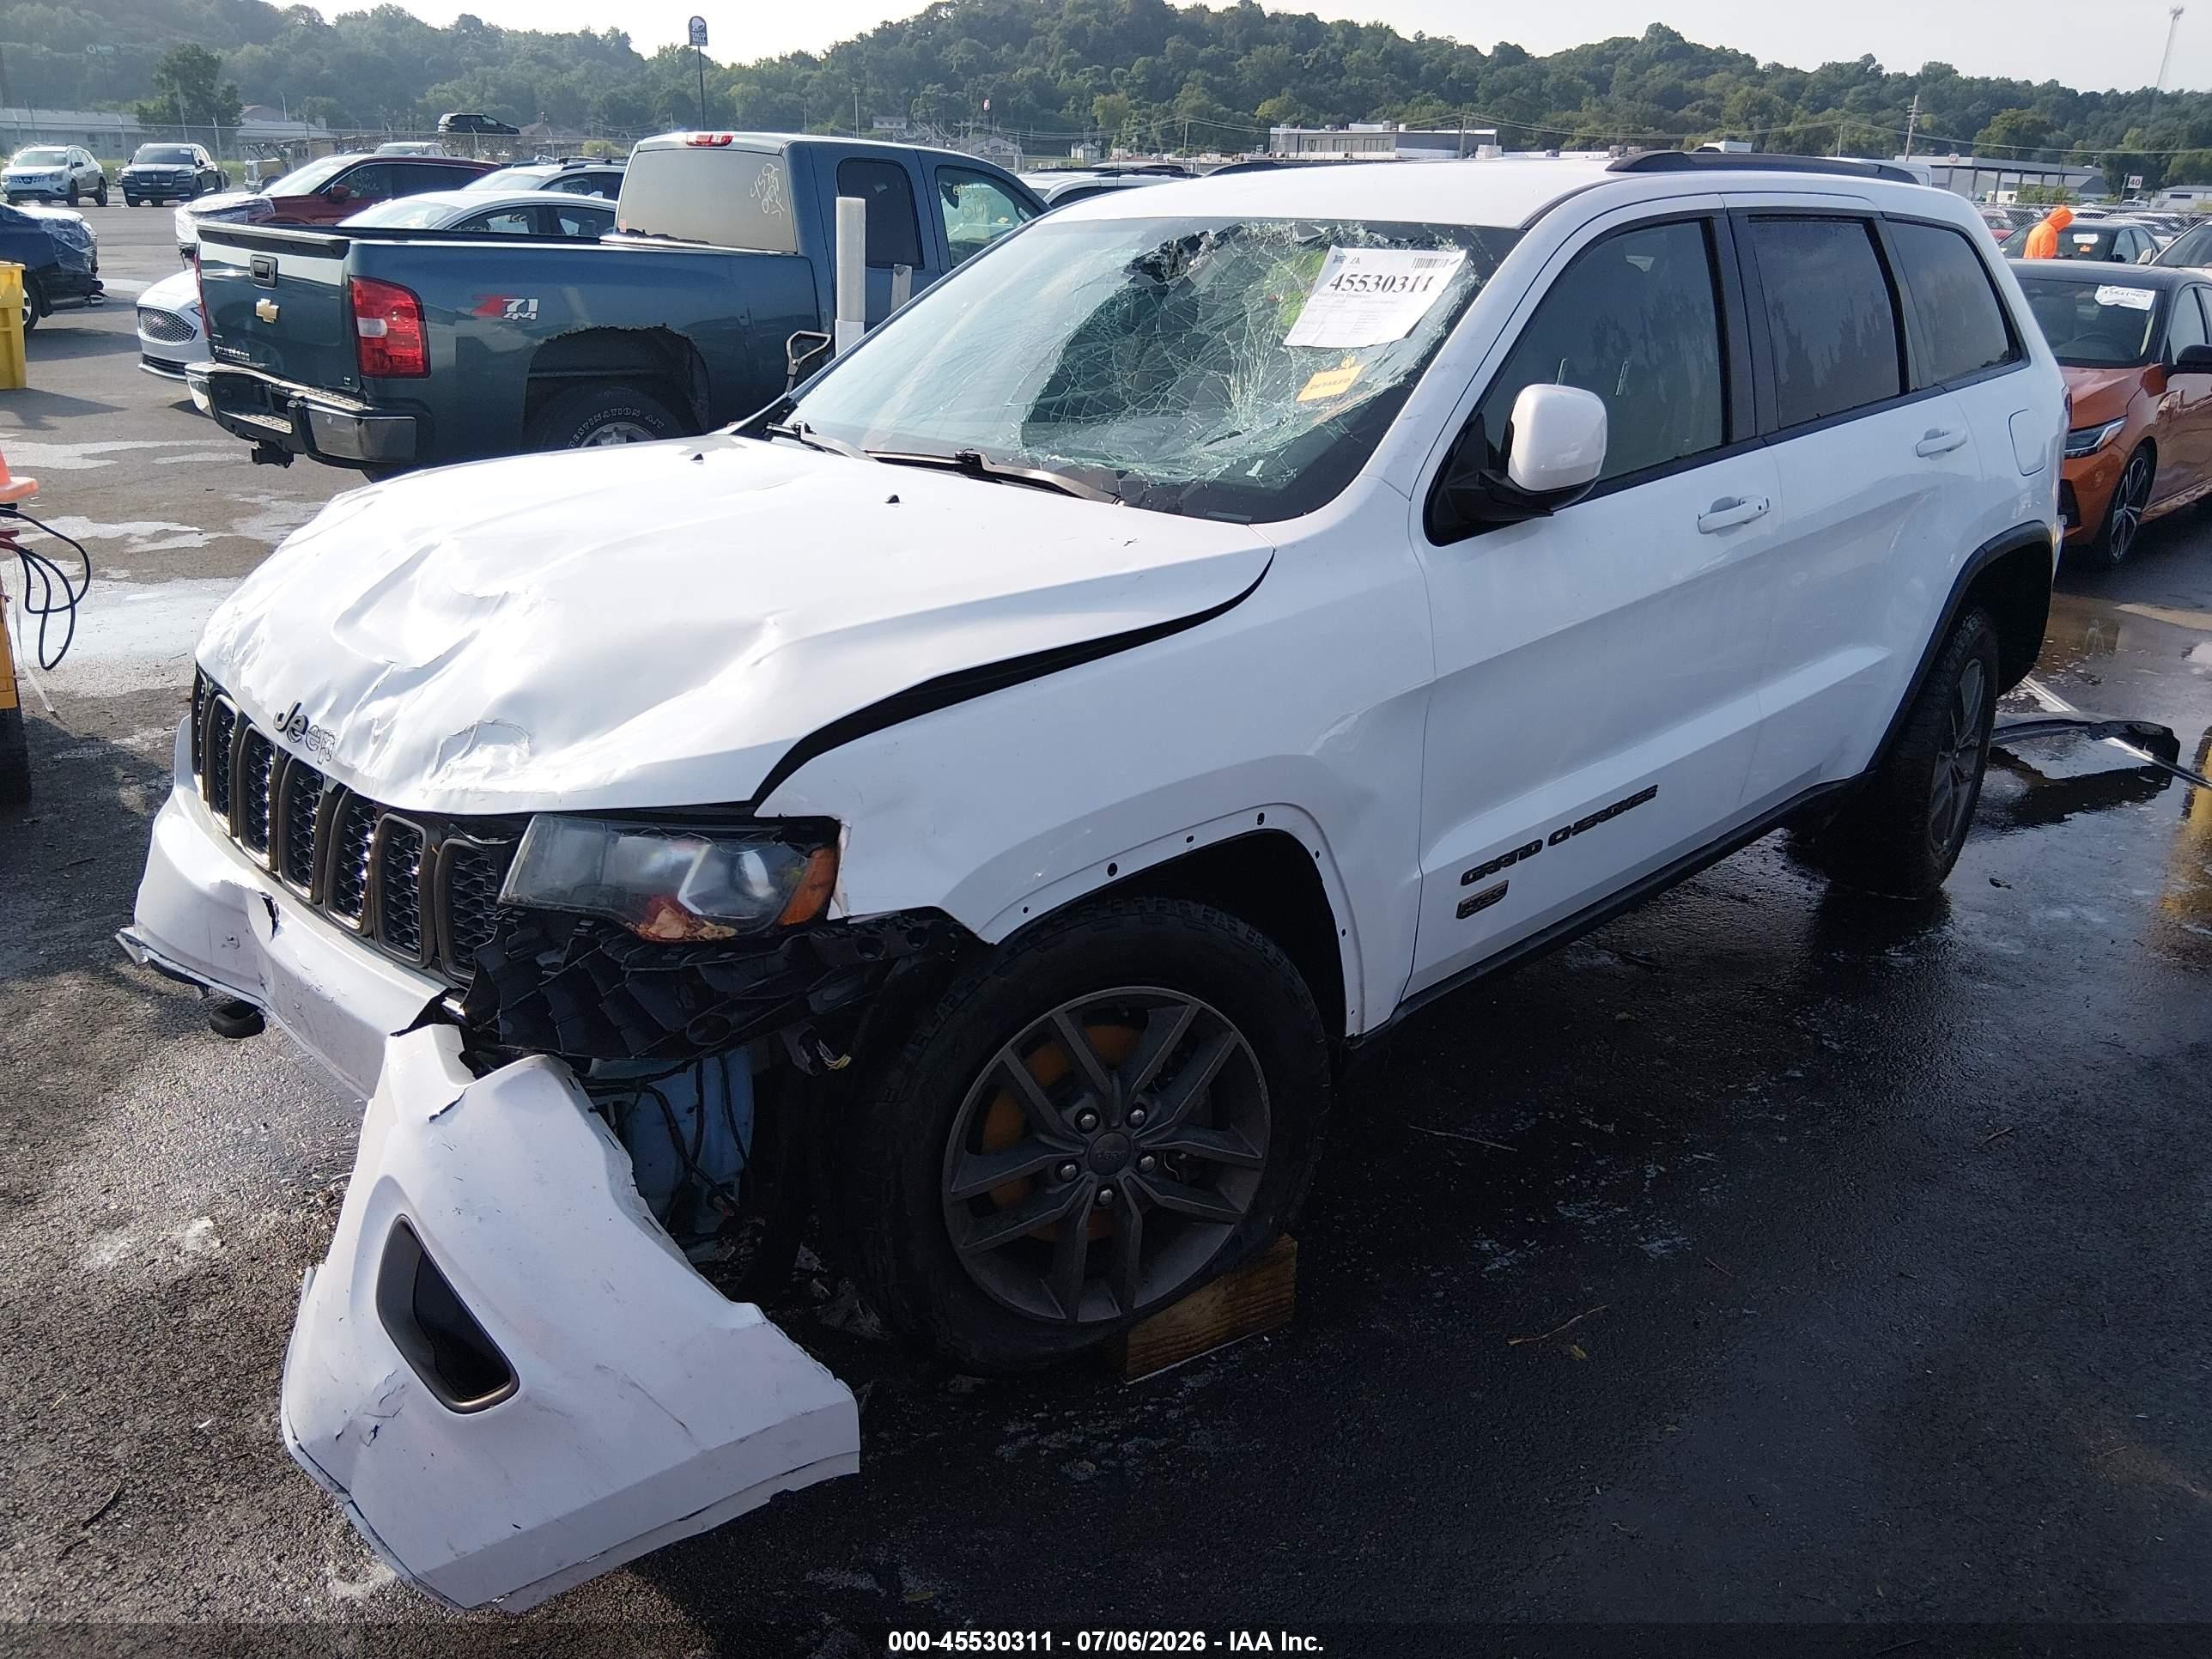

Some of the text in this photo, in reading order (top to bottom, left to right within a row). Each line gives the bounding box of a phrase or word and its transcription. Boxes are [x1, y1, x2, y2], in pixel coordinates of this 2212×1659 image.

[1329, 273, 1435, 293] 45530311
[471, 295, 538, 317] Z71
[501, 312, 537, 320] 4x4
[567, 407, 641, 447] DESTINATION
[273, 700, 336, 766] Jeep
[1461, 784, 1658, 886] GRAND CHEROKEE
